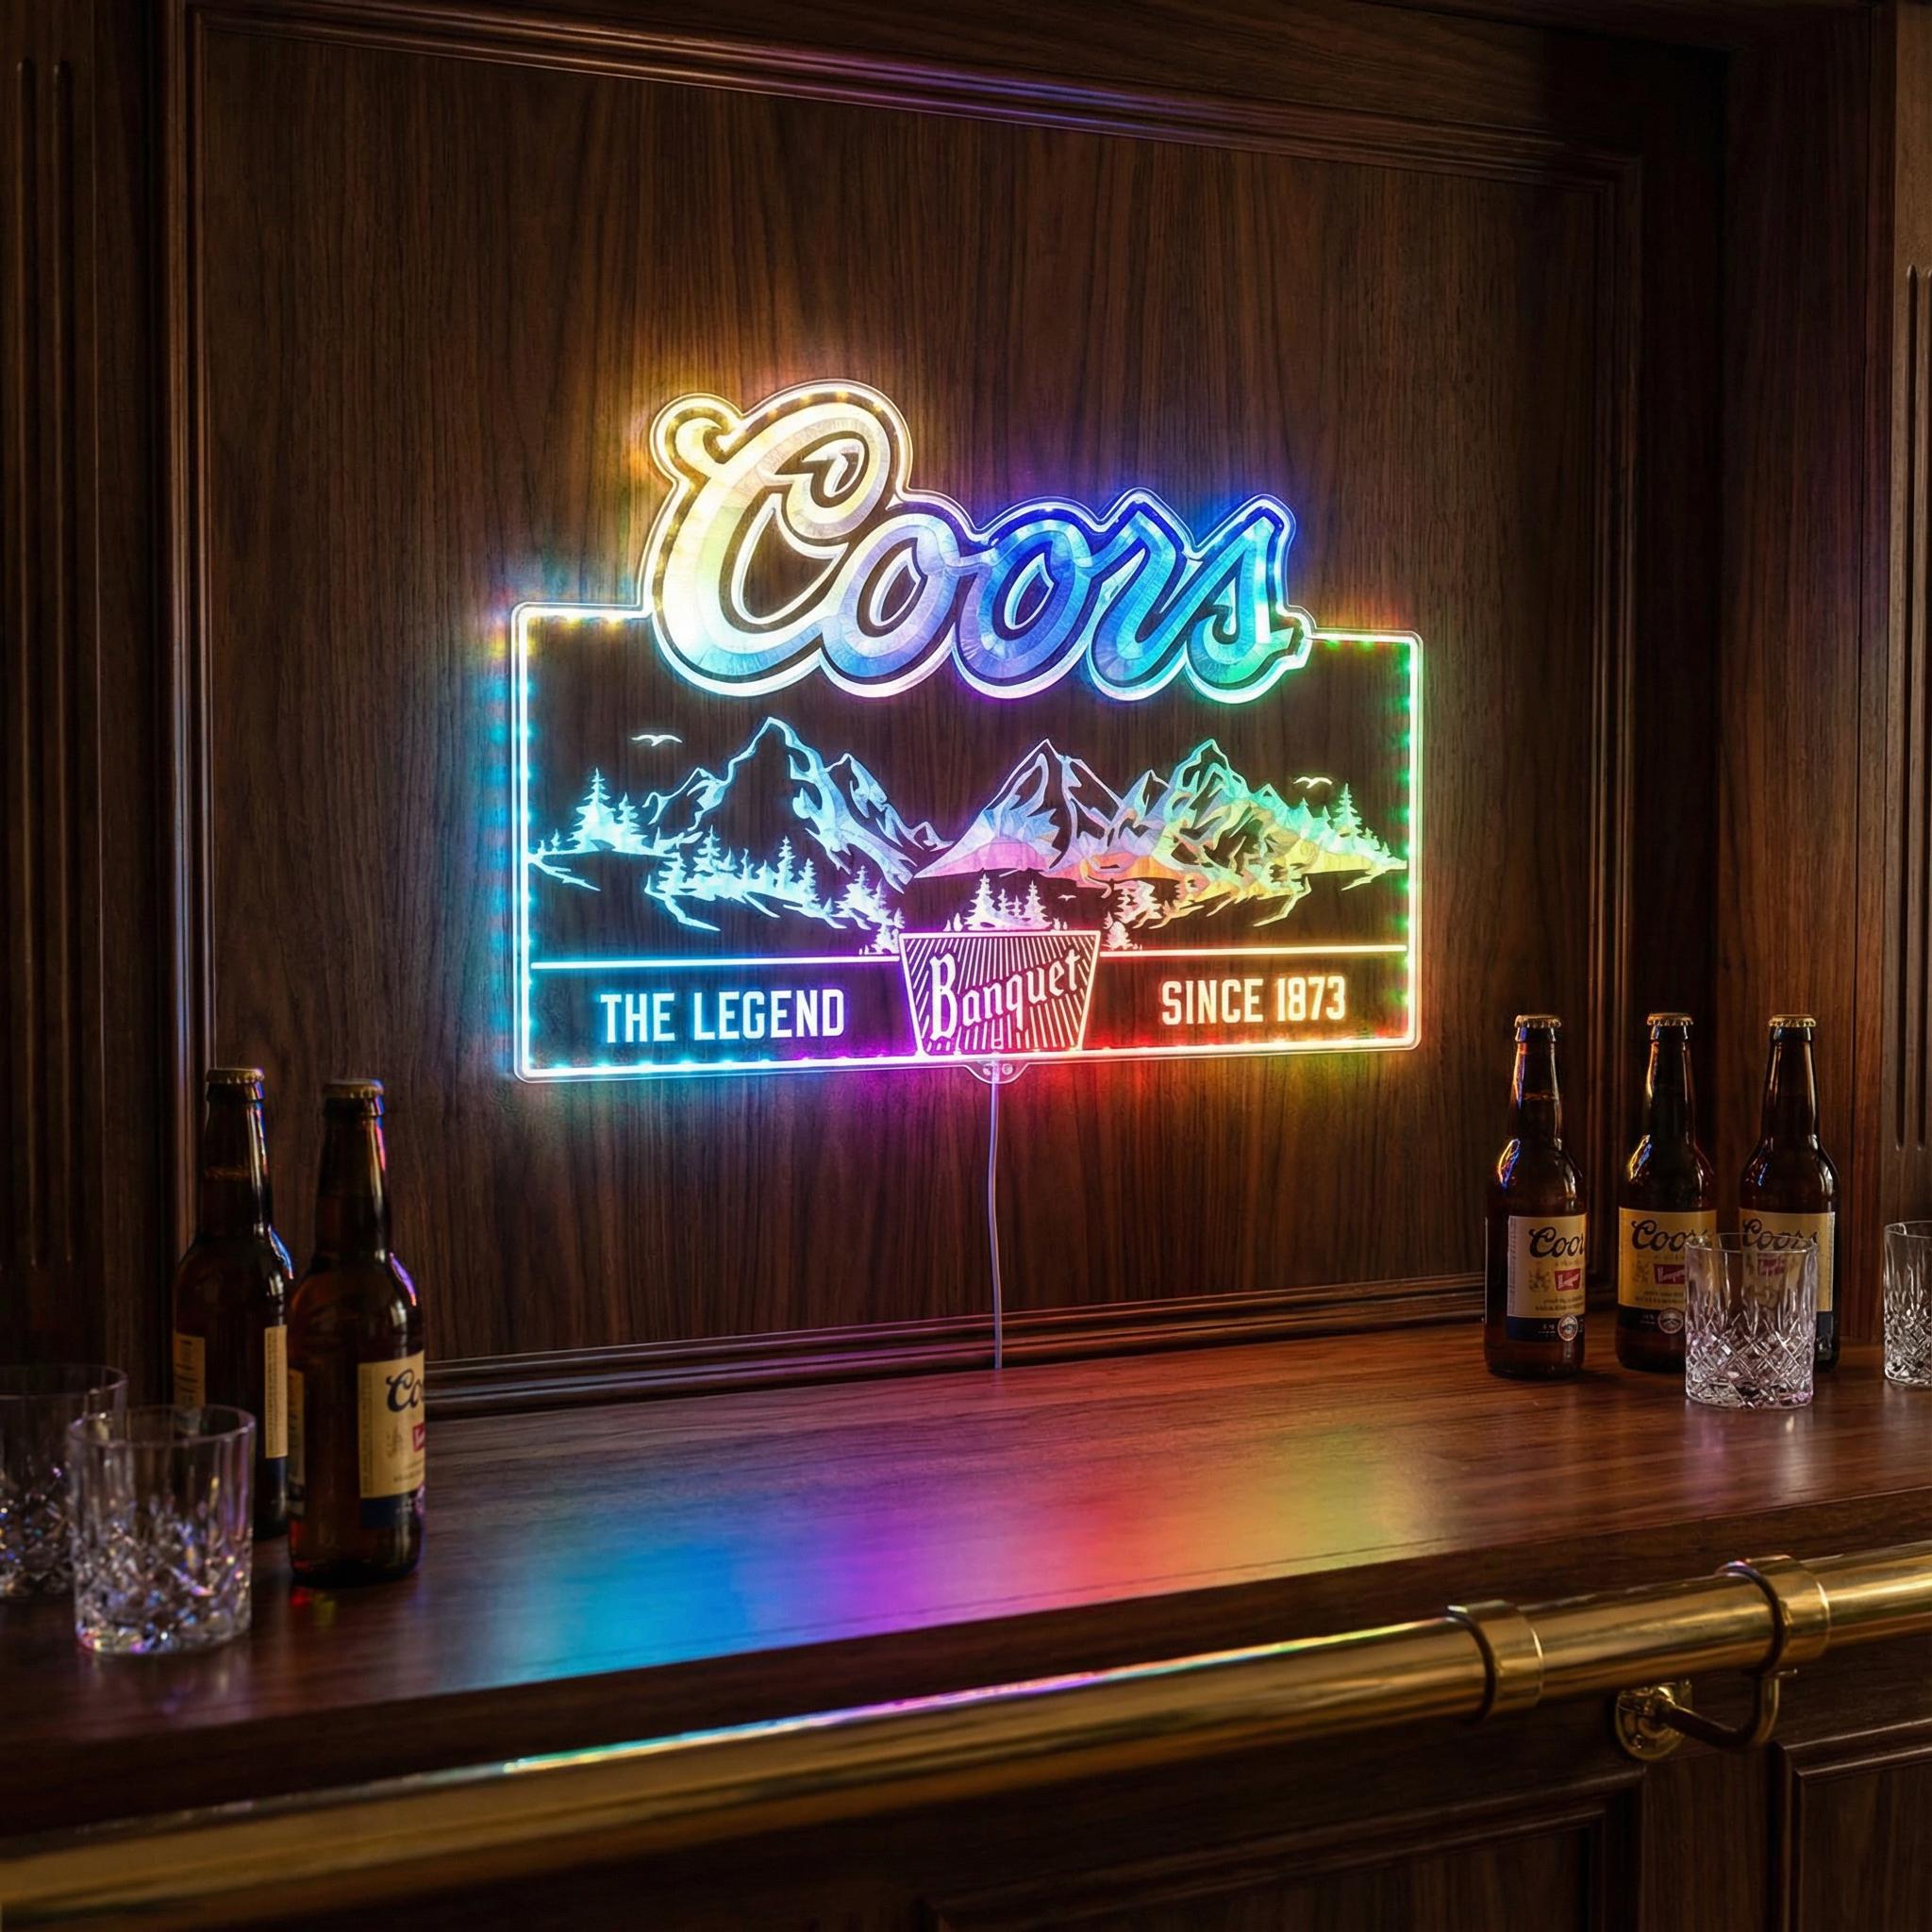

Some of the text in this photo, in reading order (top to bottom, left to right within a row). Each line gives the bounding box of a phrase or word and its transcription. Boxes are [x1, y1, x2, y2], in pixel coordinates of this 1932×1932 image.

[655, 396, 1302, 691] Coors
[600, 989, 845, 1043] THE LEGEND
[929, 948, 1081, 1041] Banquet
[1161, 975, 1346, 1025] SINCE 1873
[1631, 1219, 1710, 1252] Coo
